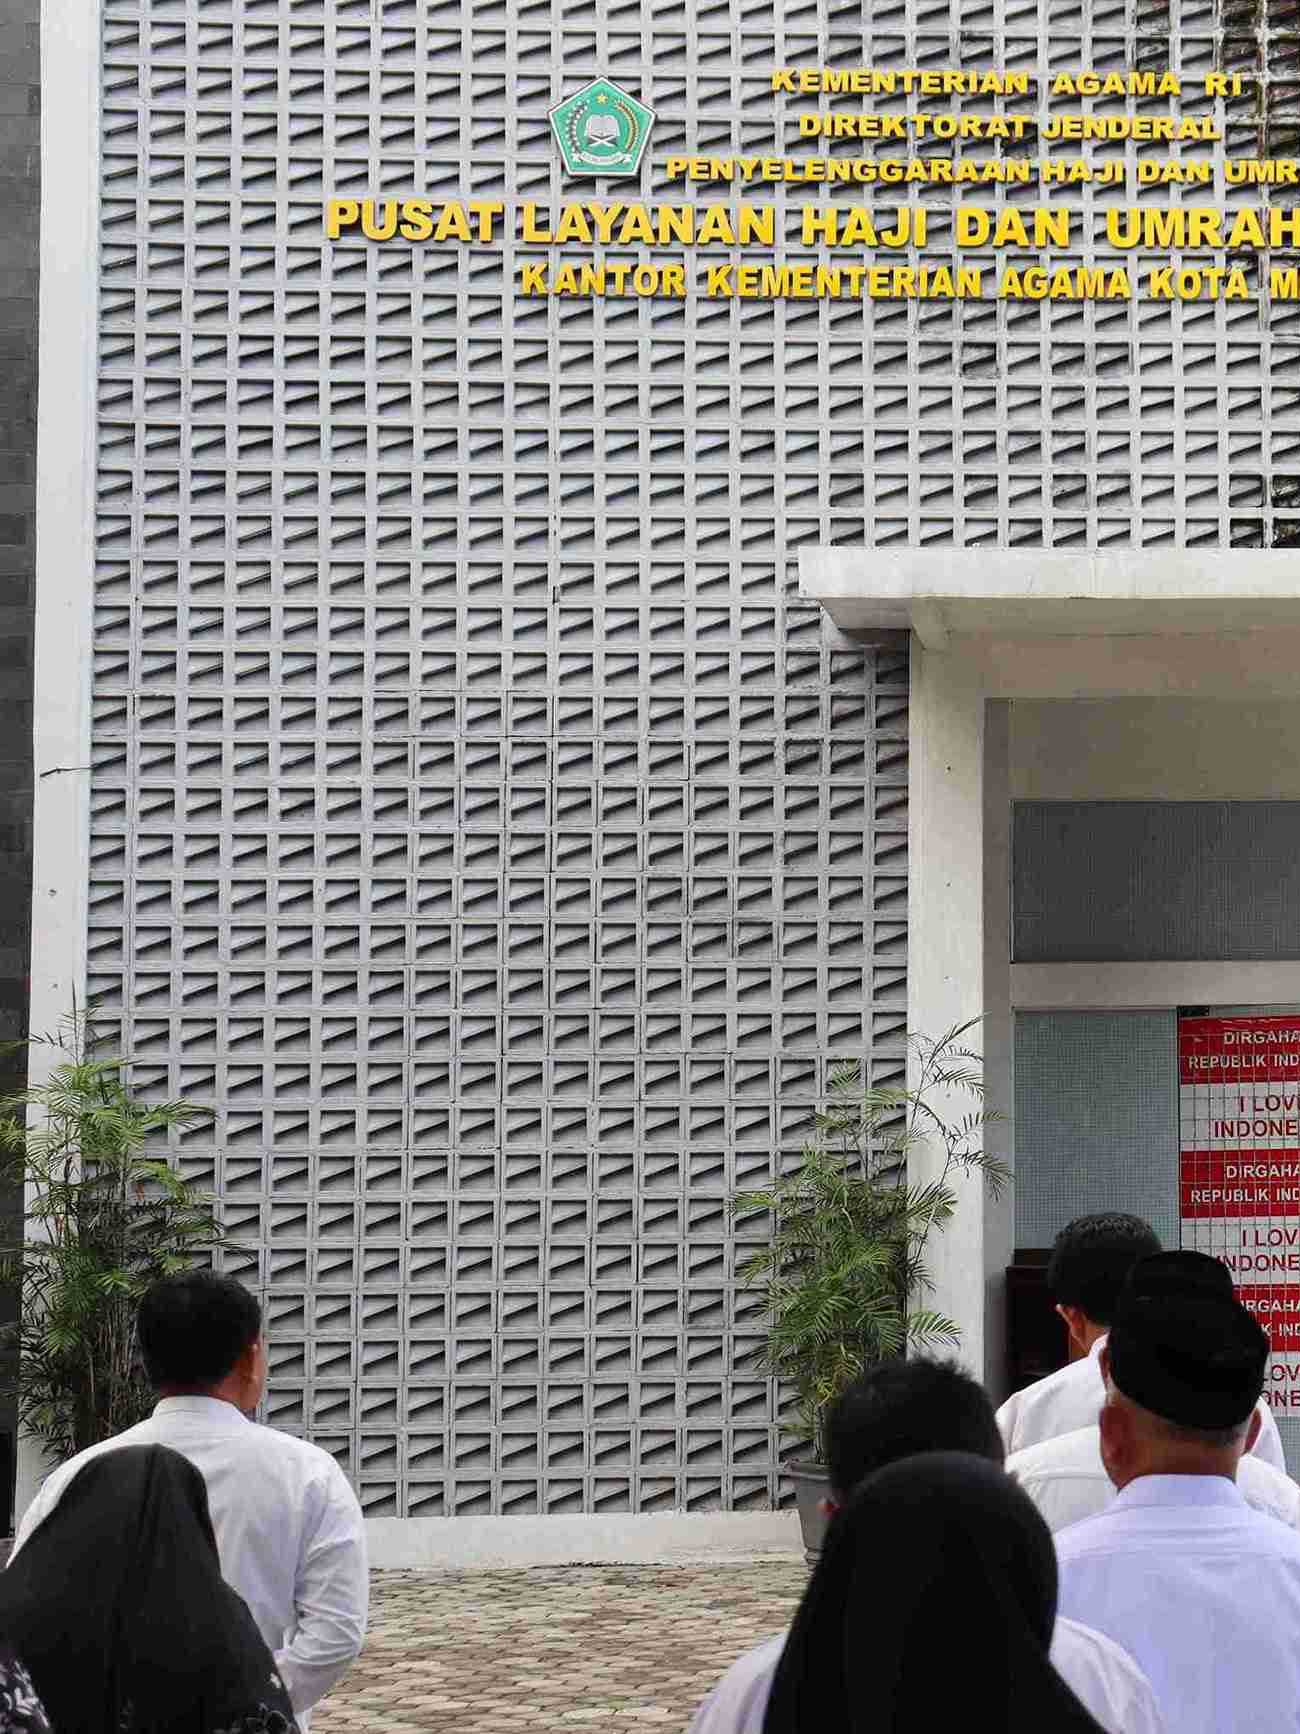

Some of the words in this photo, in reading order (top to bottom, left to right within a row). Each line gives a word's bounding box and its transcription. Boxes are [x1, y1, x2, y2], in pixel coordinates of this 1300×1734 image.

[773, 70, 1030, 95] KEMENTERIAN
[1053, 71, 1182, 96] AGAMA
[1203, 72, 1243, 97] RI
[799, 113, 1031, 139] DIREKTORAT
[1040, 115, 1222, 141] JENDERAL
[666, 157, 1032, 183] PENYELENGGARAAN
[1043, 159, 1125, 184] HAJI
[1137, 160, 1212, 184] DAN
[327, 199, 505, 243] PUSAT
[523, 203, 776, 246] LAYANAN
[802, 206, 930, 247] HAJI
[956, 207, 1072, 248] DAN
[523, 264, 688, 297] KANTOR
[706, 265, 984, 299] KEMENTERIAN
[999, 266, 1132, 300] AGAMA
[1151, 266, 1250, 300] KOTA
[1188, 1055, 1267, 1069] REPUBLIK
[1239, 1095, 1245, 1112] I
[1191, 1189, 1270, 1203] REPUBLIK
[1242, 1229, 1247, 1246] I
